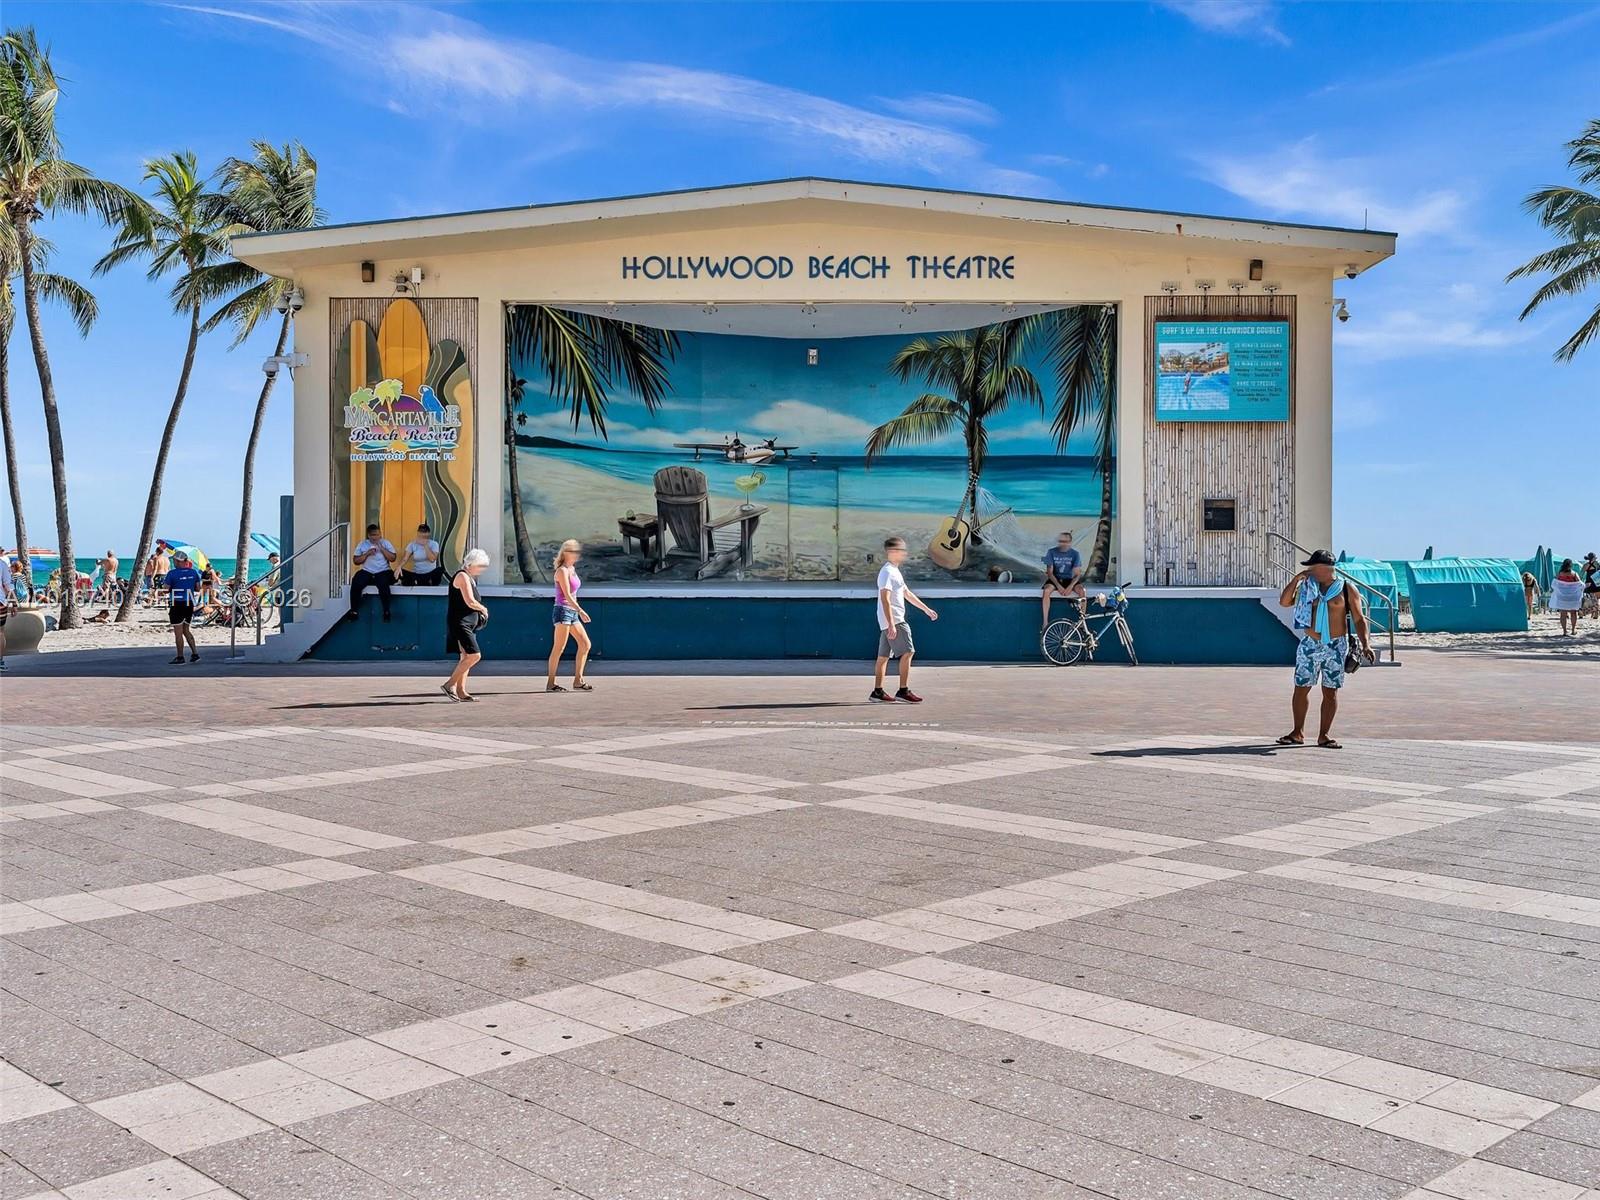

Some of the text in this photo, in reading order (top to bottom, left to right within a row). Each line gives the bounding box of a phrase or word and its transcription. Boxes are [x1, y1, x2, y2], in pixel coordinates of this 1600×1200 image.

[622, 255, 1015, 280] HOLLYWOOD BEACH THEATRE
[1162, 326, 1185, 335] SURF'S
[1185, 326, 1195, 335] UP
[1206, 326, 1218, 335] THE
[350, 427, 457, 442] Beach Resort
[351, 452, 406, 461] HOLLYWOOD
[410, 452, 440, 462] BEACH,
